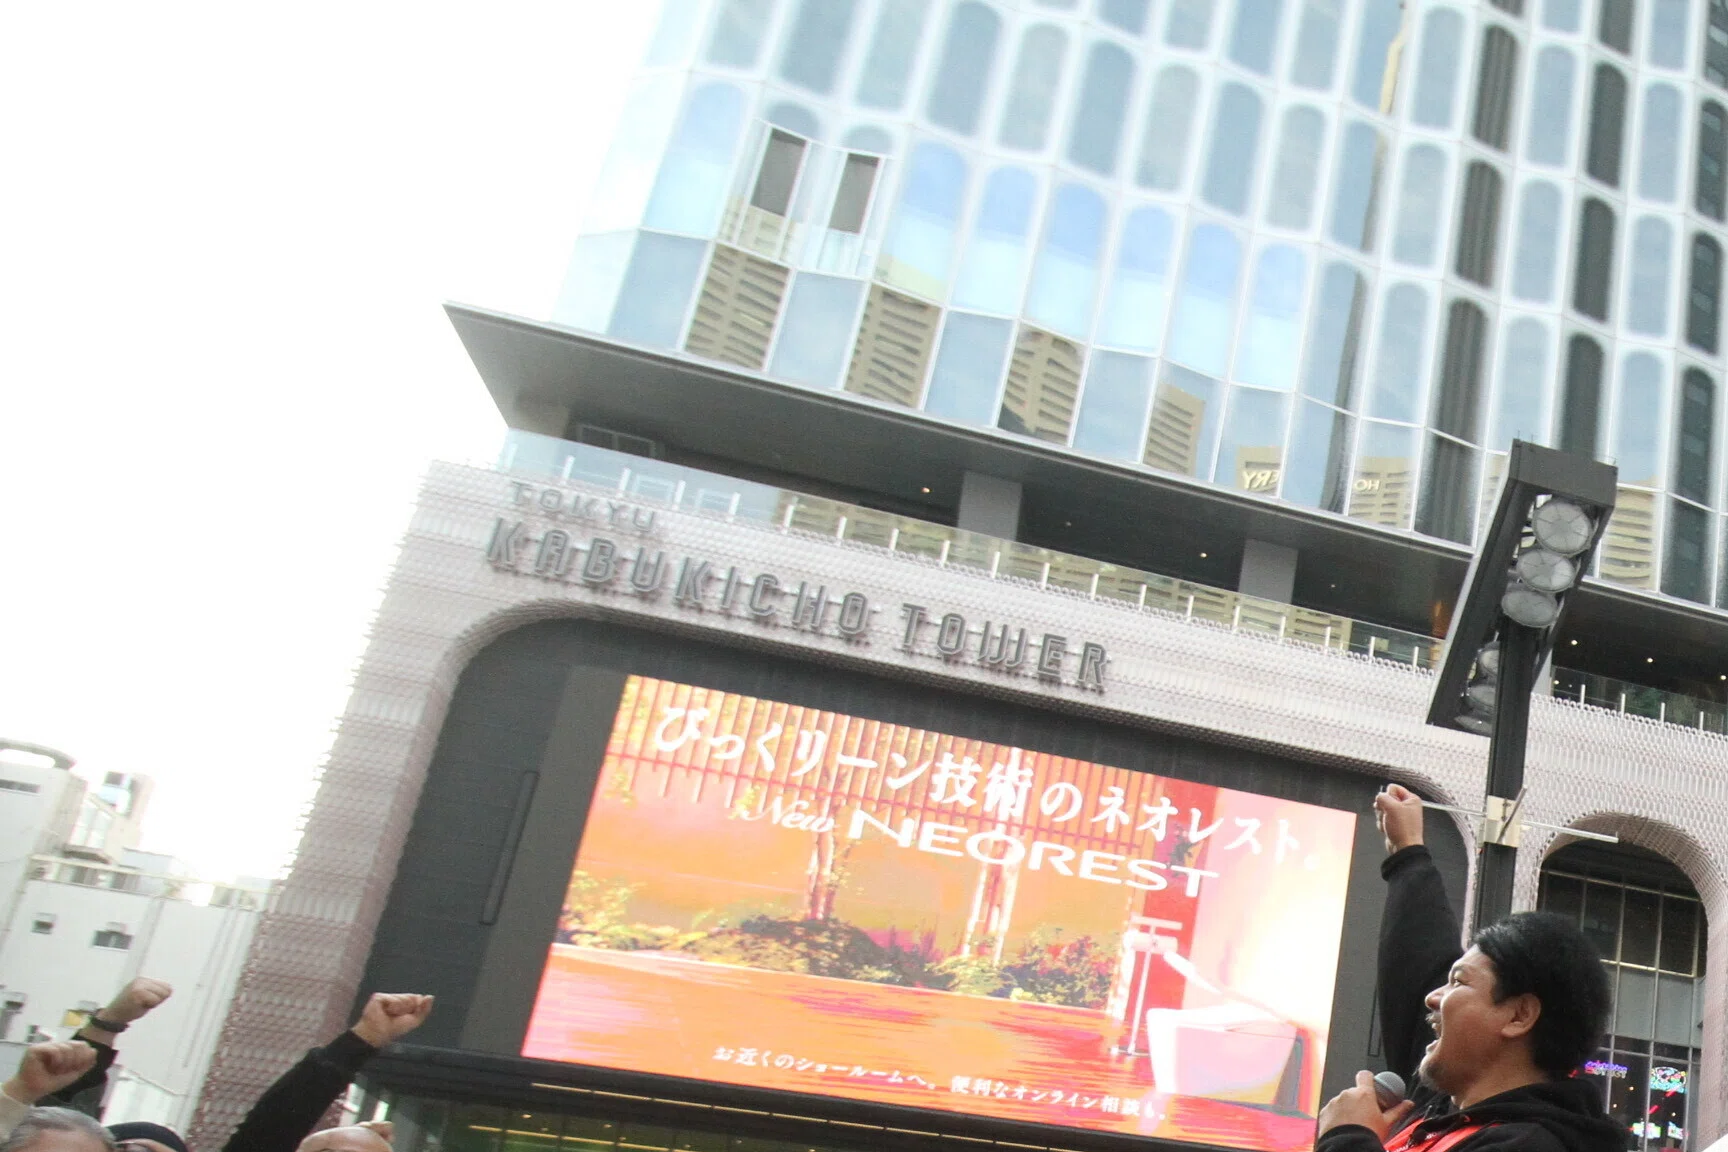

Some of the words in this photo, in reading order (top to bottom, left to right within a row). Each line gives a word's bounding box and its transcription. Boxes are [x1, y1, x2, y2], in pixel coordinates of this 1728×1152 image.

[512, 480, 656, 533] TOKYU
[487, 517, 870, 636] KABUKICHO
[902, 602, 1110, 692] TOWER
[738, 796, 838, 833] New
[848, 809, 1221, 899] NEOREST
